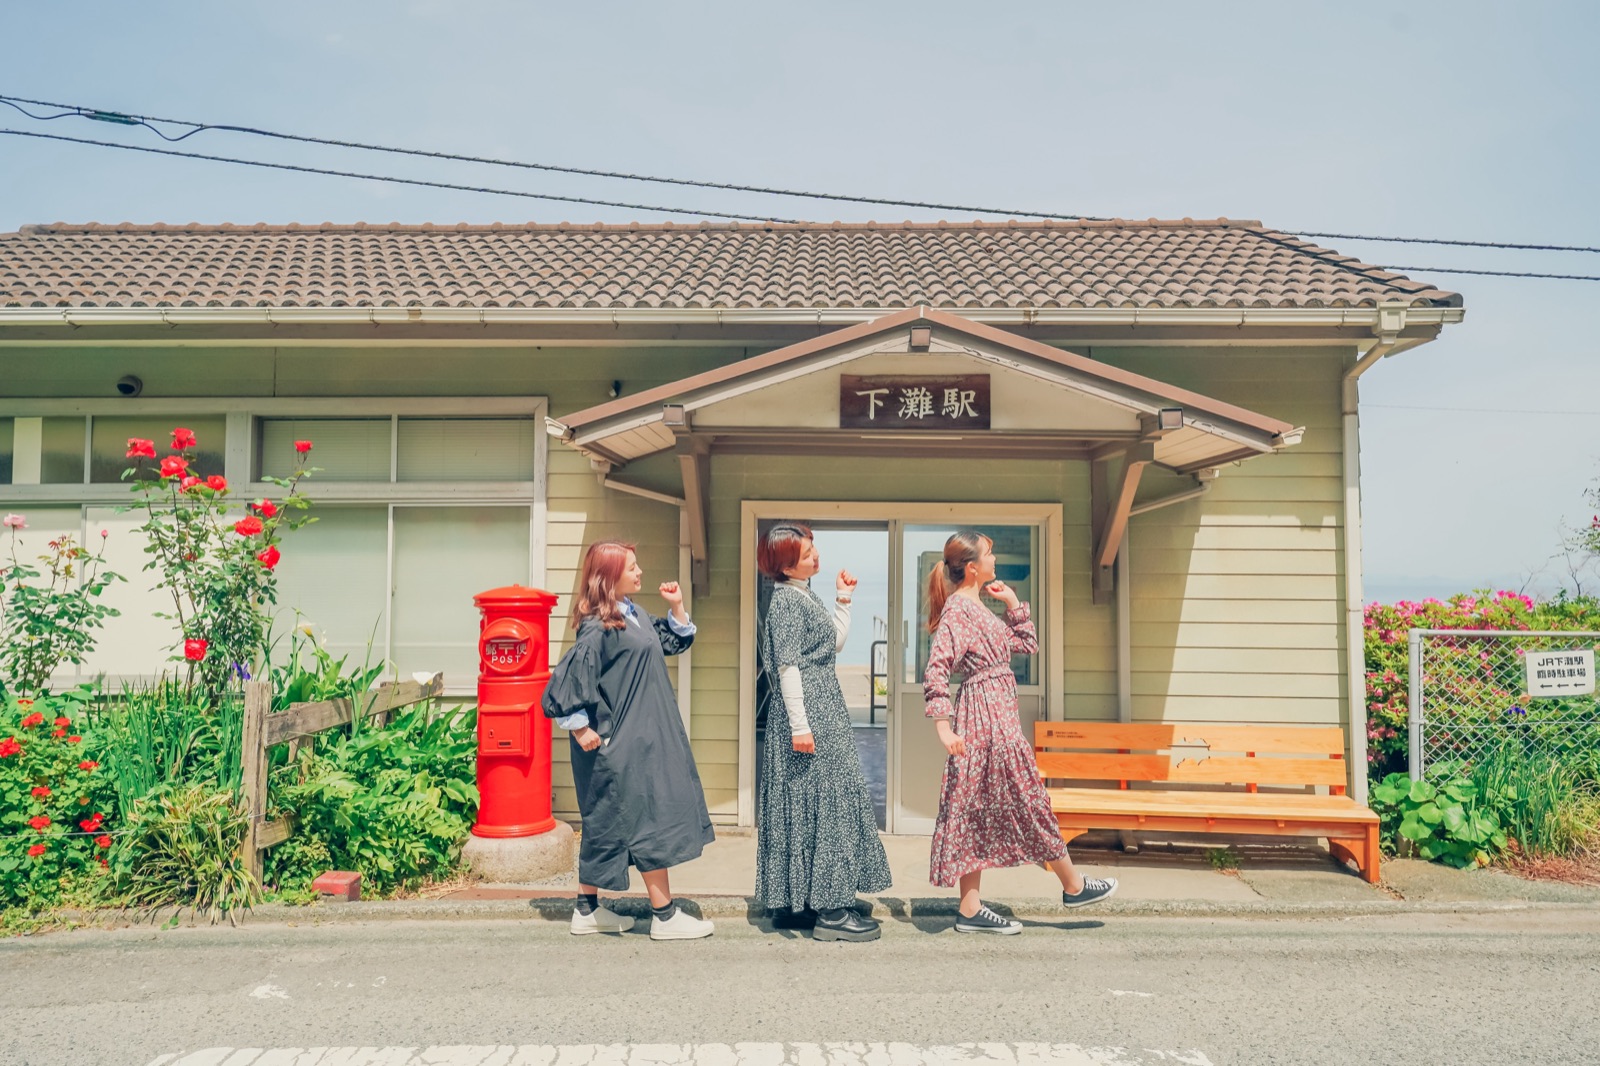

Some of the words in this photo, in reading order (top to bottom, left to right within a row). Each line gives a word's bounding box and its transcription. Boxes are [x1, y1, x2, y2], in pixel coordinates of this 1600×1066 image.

[856, 387, 979, 420] 下灘駅
[491, 655, 521, 664] POST
[1537, 656, 1584, 667] JR下灘駅
[1537, 668, 1587, 679] 臨時駐車場
